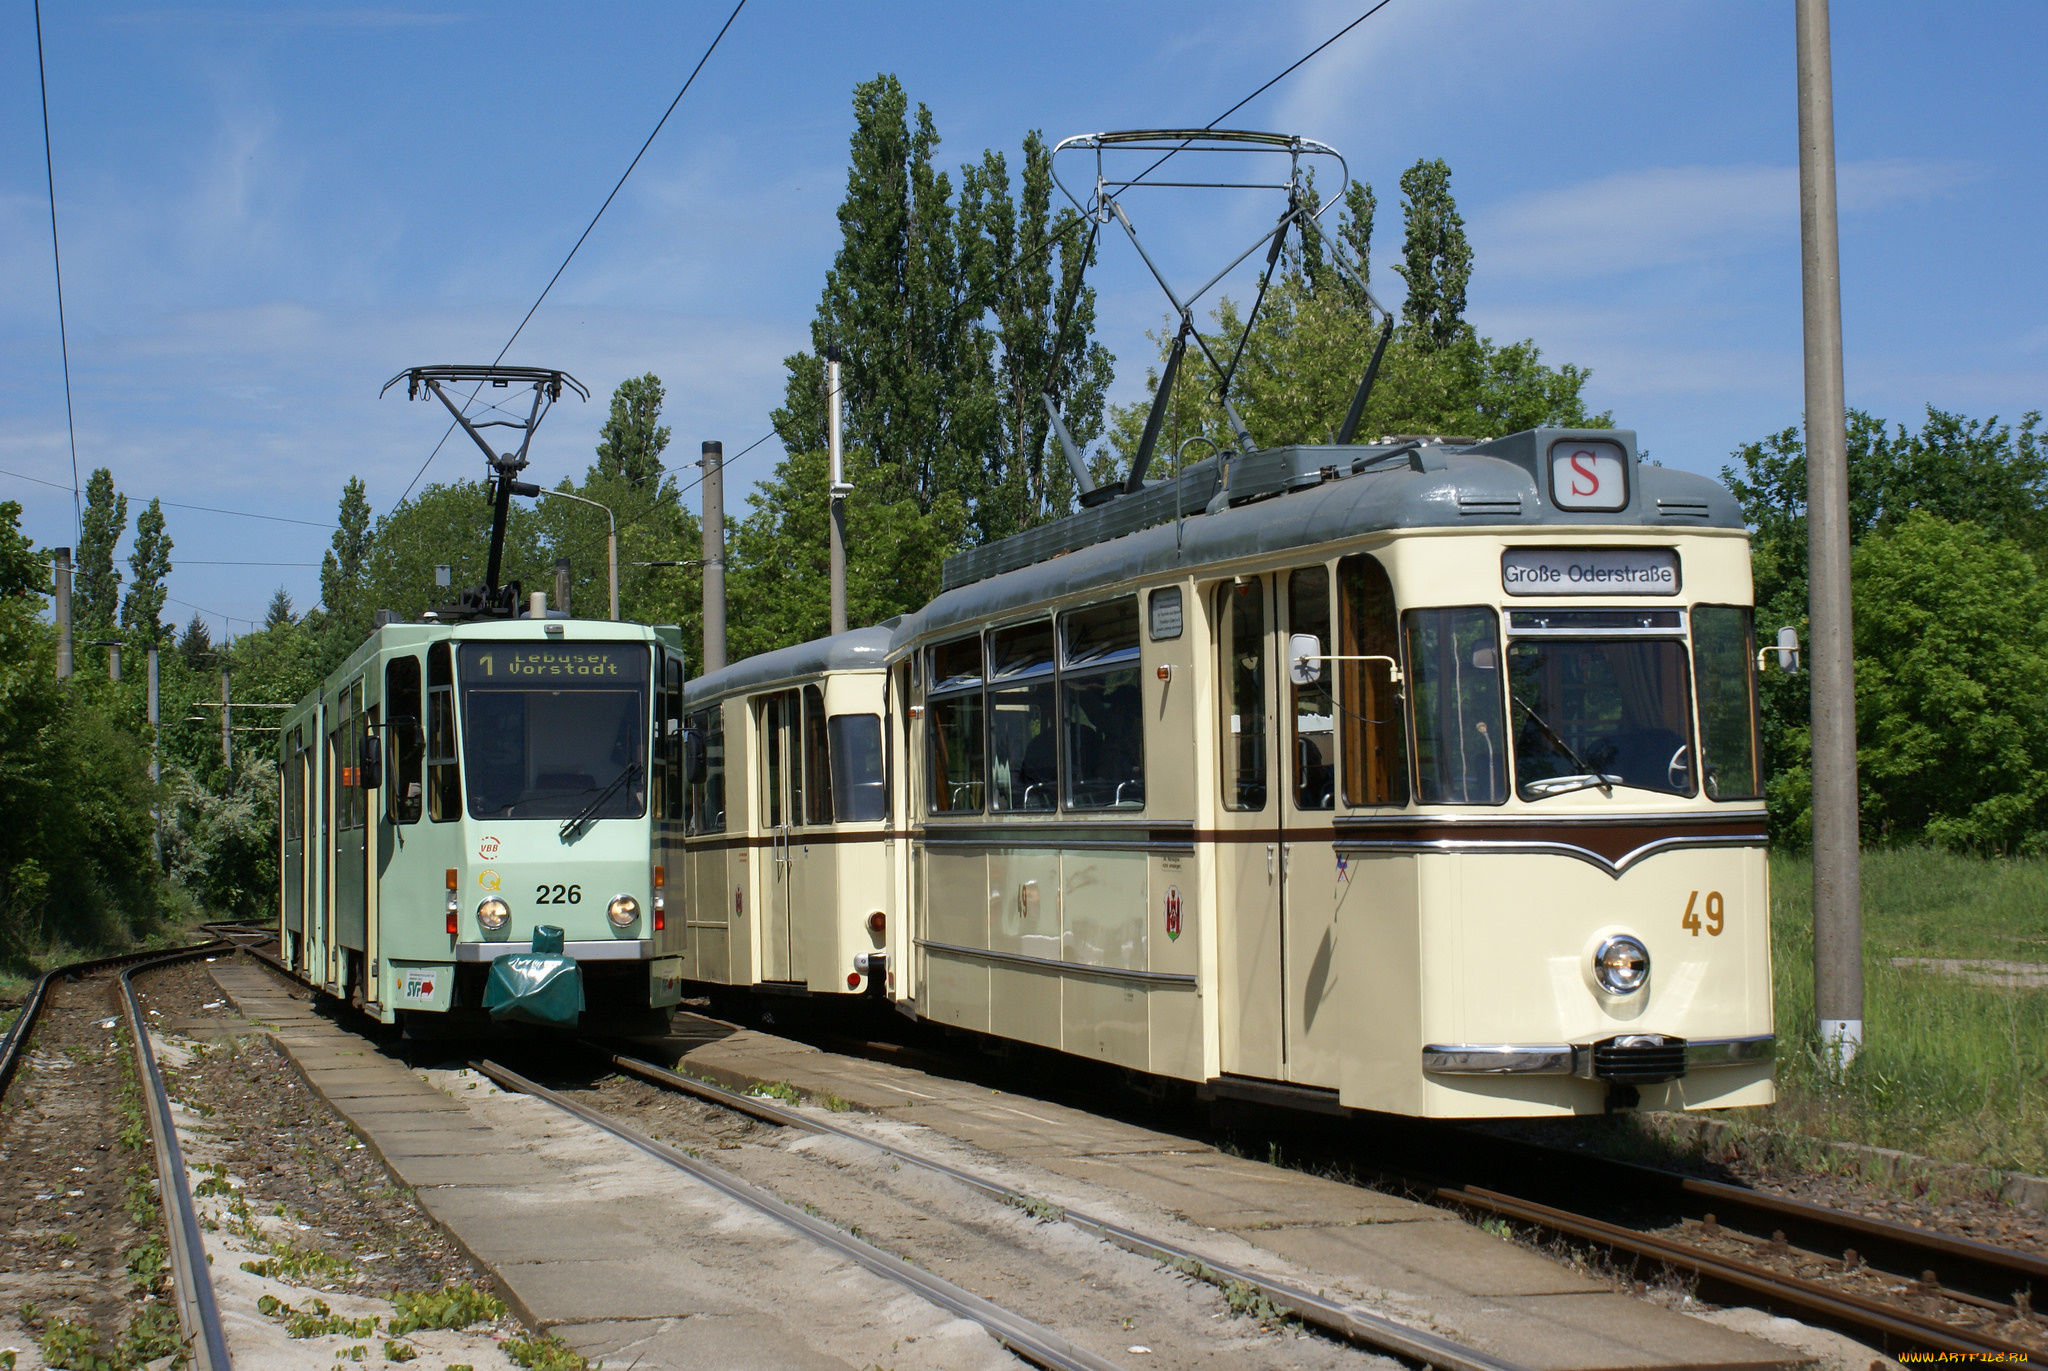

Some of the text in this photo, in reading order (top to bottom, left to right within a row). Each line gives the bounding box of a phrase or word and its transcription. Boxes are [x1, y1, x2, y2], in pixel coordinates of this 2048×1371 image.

[1570, 450, 1599, 496] S
[1504, 564, 1672, 583] Große Oderstraße
[479, 652, 493, 676] 1
[509, 662, 617, 675] Vorstadt
[481, 844, 499, 852] VBB
[536, 884, 582, 905] 226
[1682, 890, 1724, 937] 49
